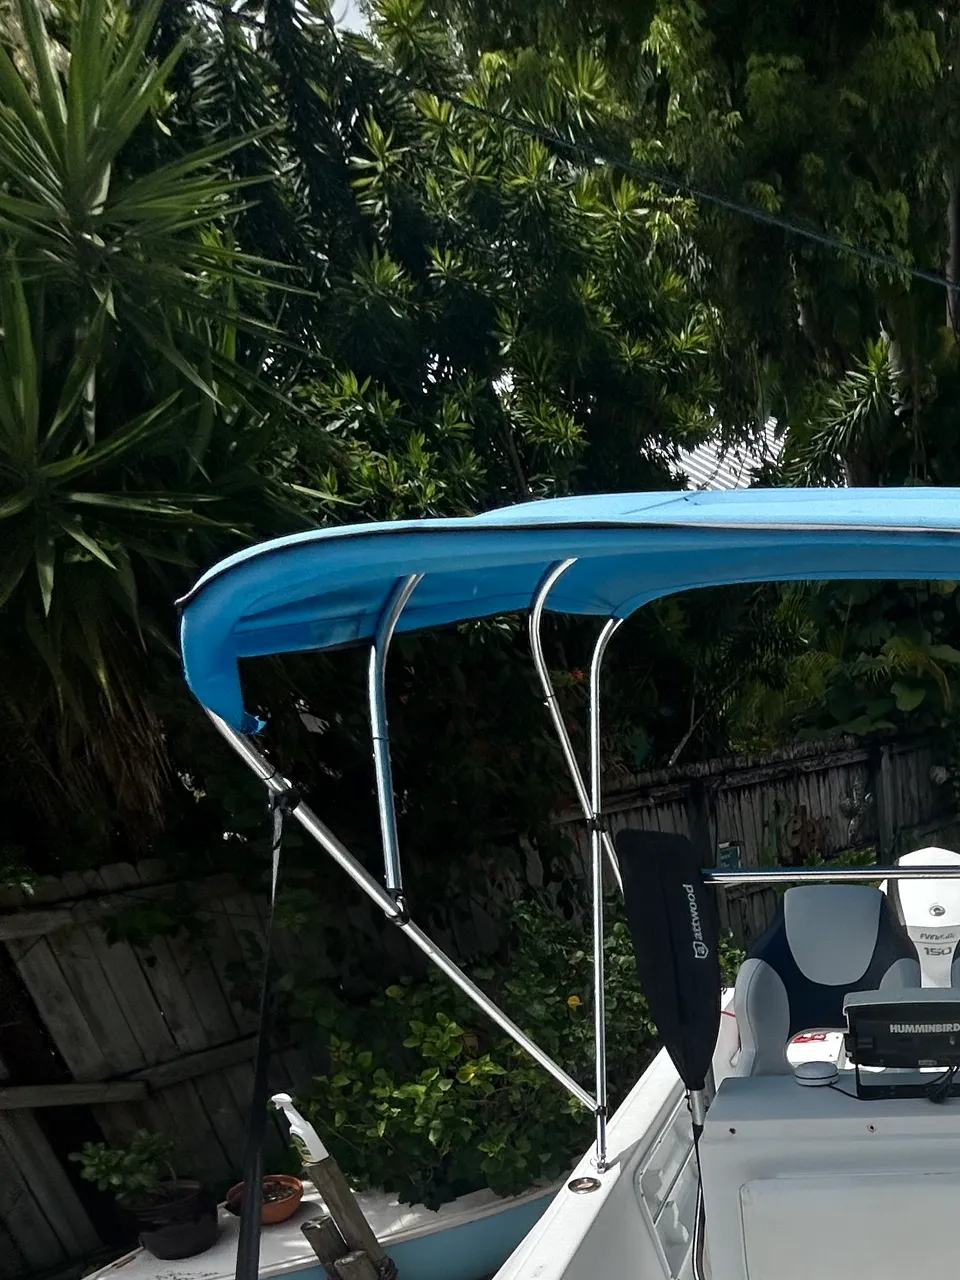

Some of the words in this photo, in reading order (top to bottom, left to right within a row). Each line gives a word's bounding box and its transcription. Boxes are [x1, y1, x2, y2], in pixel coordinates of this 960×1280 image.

[682, 883, 703, 940] attwood
[924, 946, 952, 956] 150
[889, 1023, 960, 1034] HUMMINBIRD
